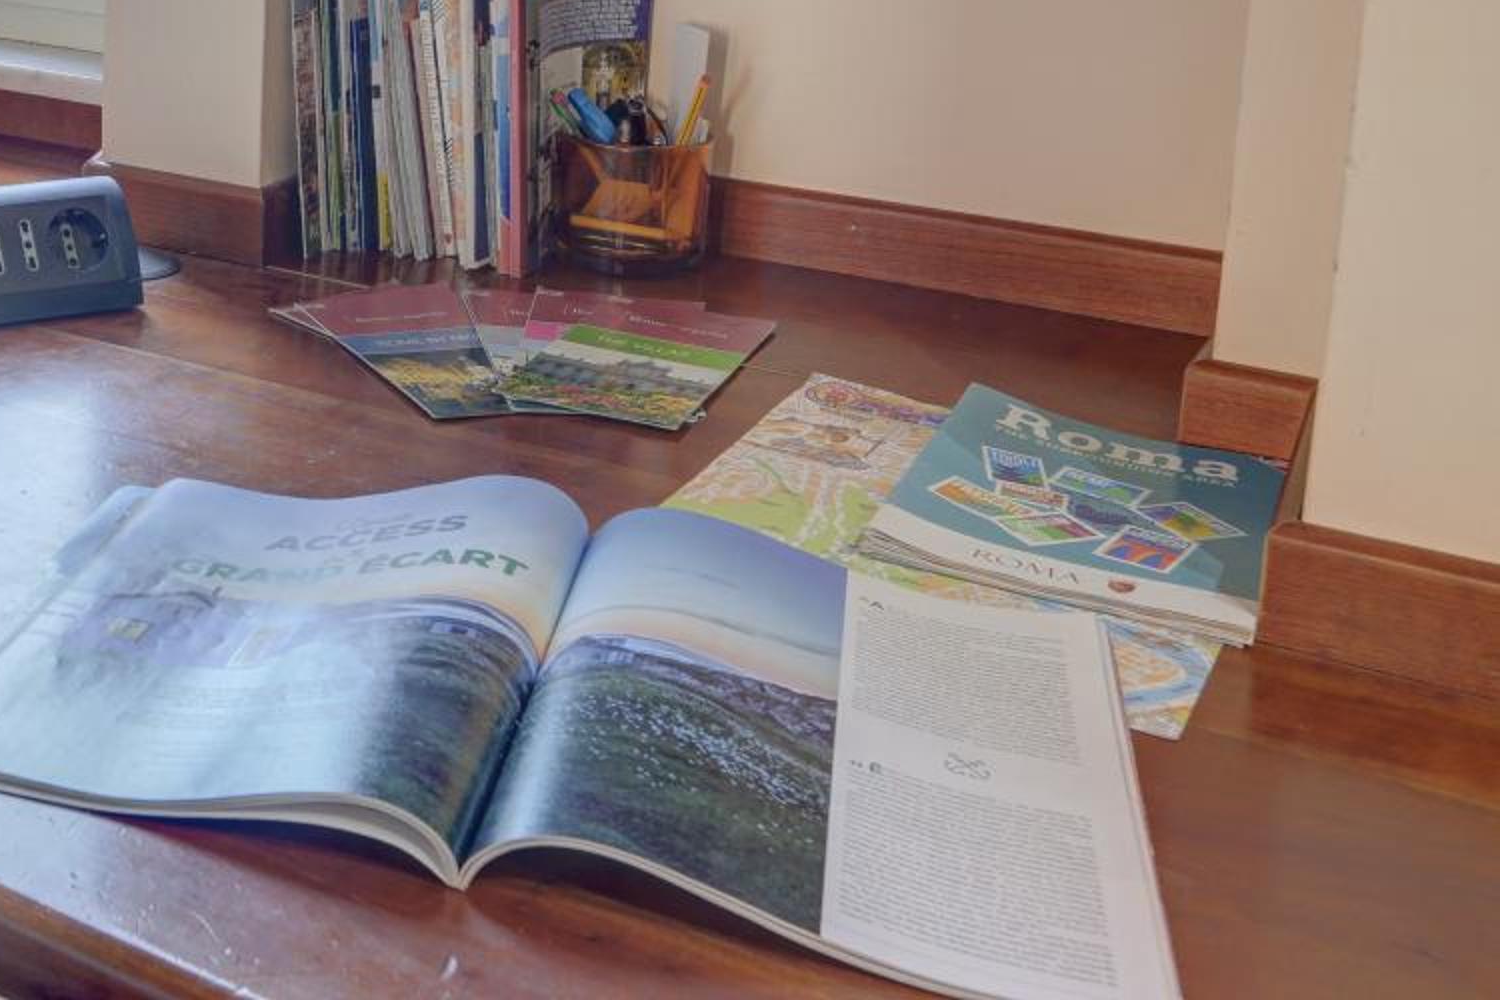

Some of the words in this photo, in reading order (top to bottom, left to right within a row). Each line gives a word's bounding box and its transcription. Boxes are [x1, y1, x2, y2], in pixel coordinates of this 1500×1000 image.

[995, 403, 1239, 482] Roma
[264, 515, 469, 551] ACCESS
[972, 547, 1081, 586] ROMA
